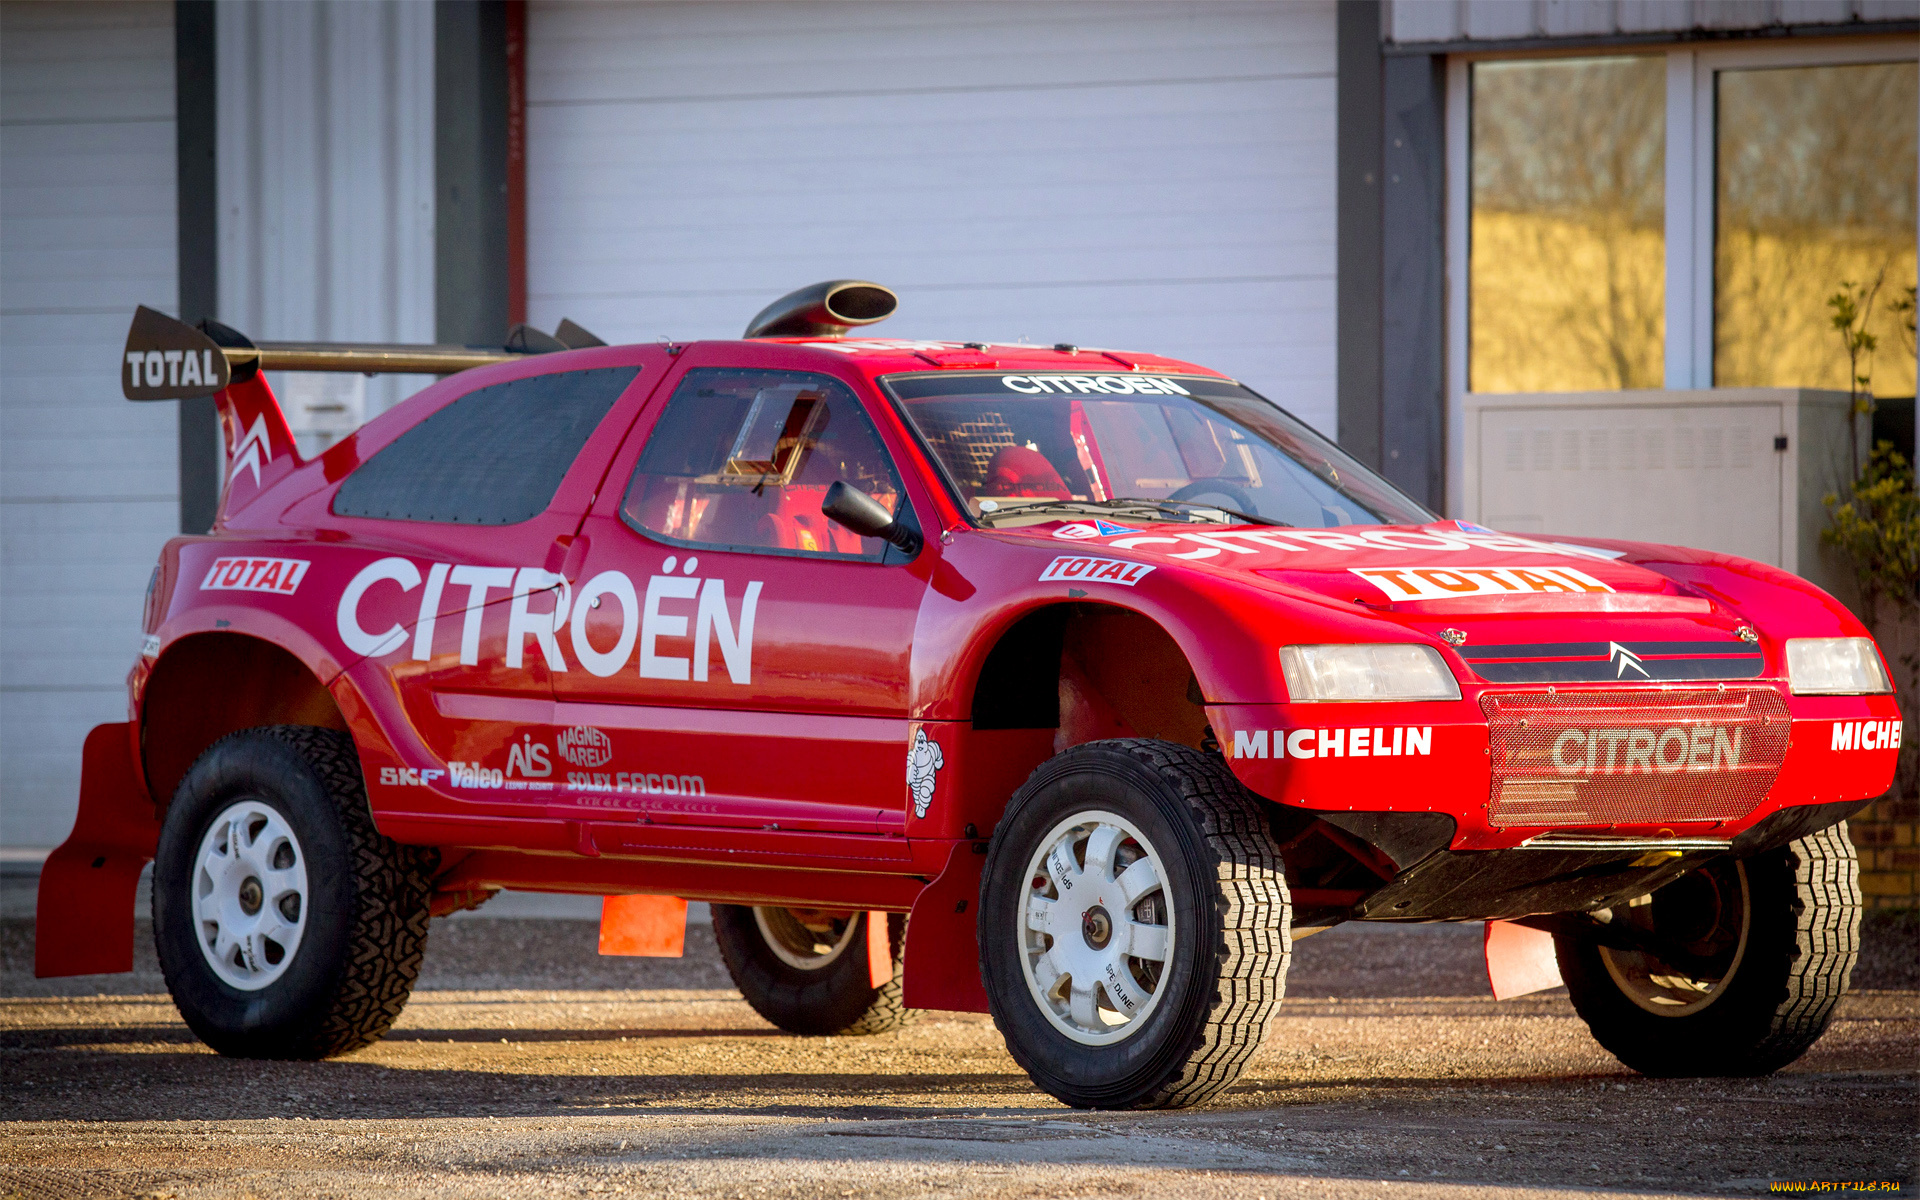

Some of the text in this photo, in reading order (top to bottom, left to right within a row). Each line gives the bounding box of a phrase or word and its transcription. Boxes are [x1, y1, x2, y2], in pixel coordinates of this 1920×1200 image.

[126, 350, 219, 387] TOTAL
[207, 560, 300, 591] TOTAL
[1048, 557, 1144, 583] TOTAL
[1359, 569, 1610, 595] TOTAL
[336, 555, 764, 685] CITROËN
[1234, 726, 1432, 760] MICHELIN
[380, 767, 445, 786] SKF
[447, 761, 503, 789] Valeo
[567, 771, 612, 792] SOLEX
